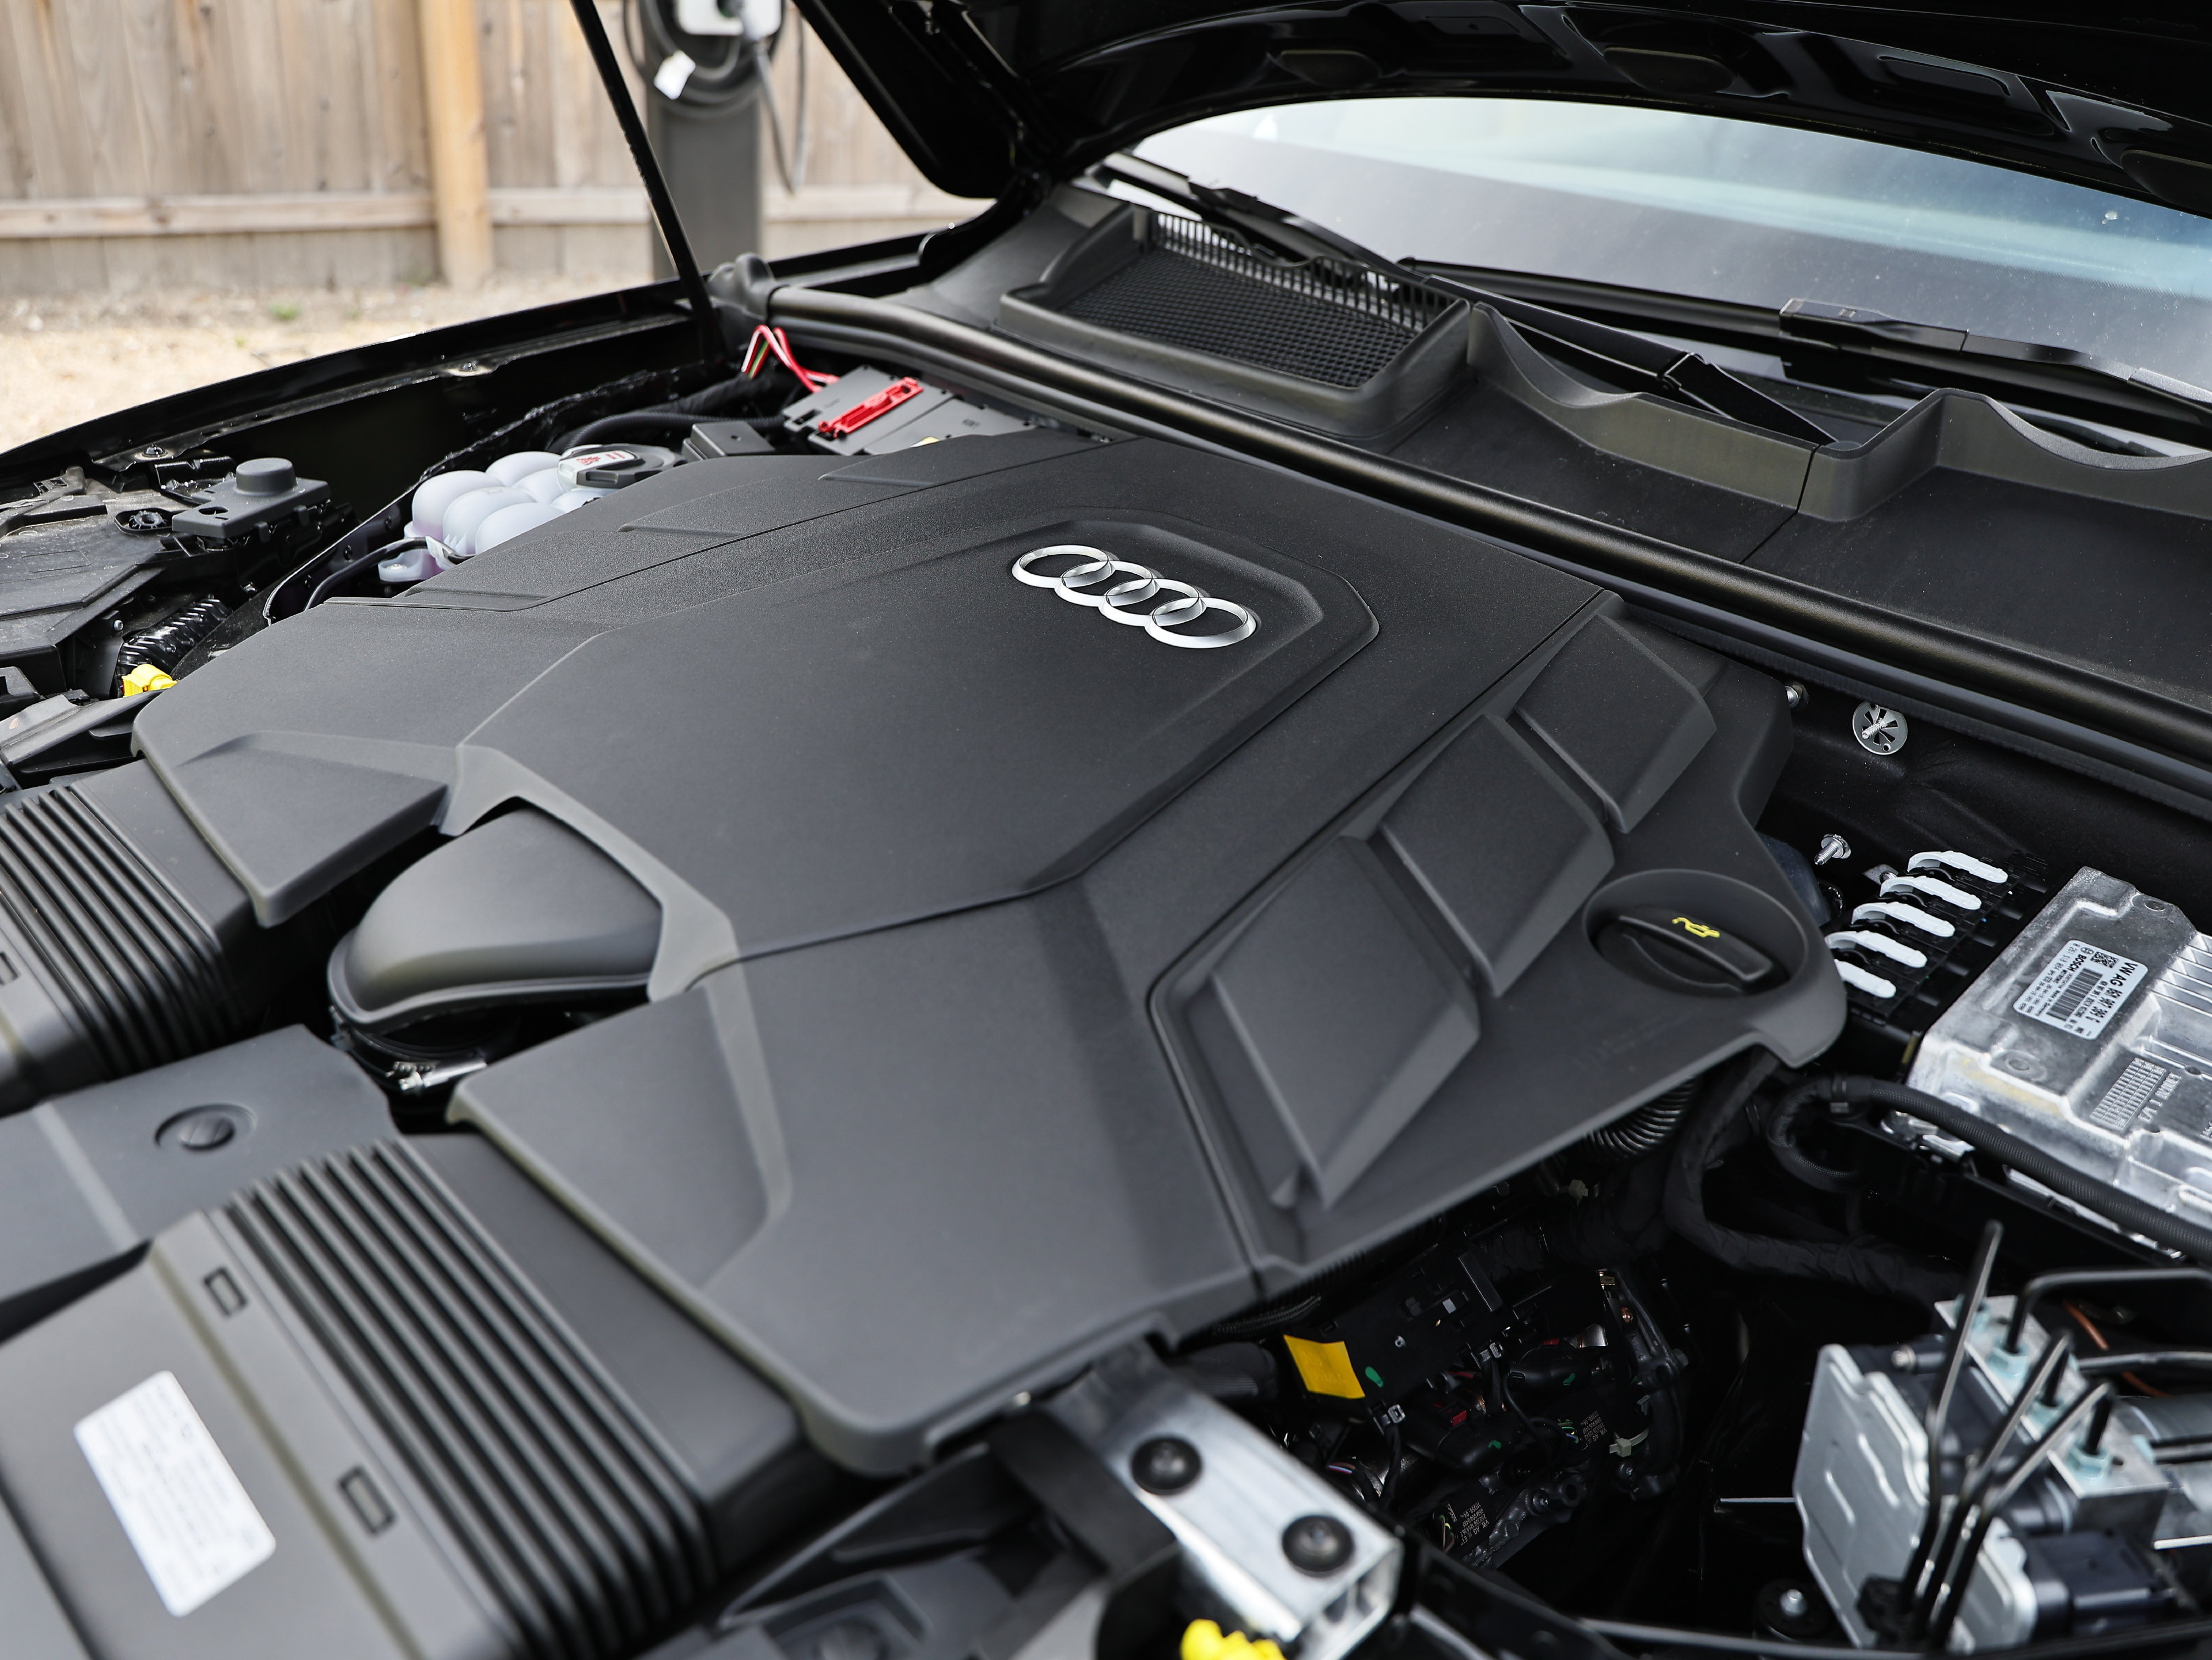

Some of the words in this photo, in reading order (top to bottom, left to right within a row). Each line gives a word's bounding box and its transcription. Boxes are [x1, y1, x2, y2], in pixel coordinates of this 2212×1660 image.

[2068, 954, 2086, 972] BOSCH
[2119, 962, 2138, 975] VW
[2111, 973, 2126, 987] AG
[1473, 1526, 1480, 1534] AG
[1482, 1519, 1490, 1529] VW
